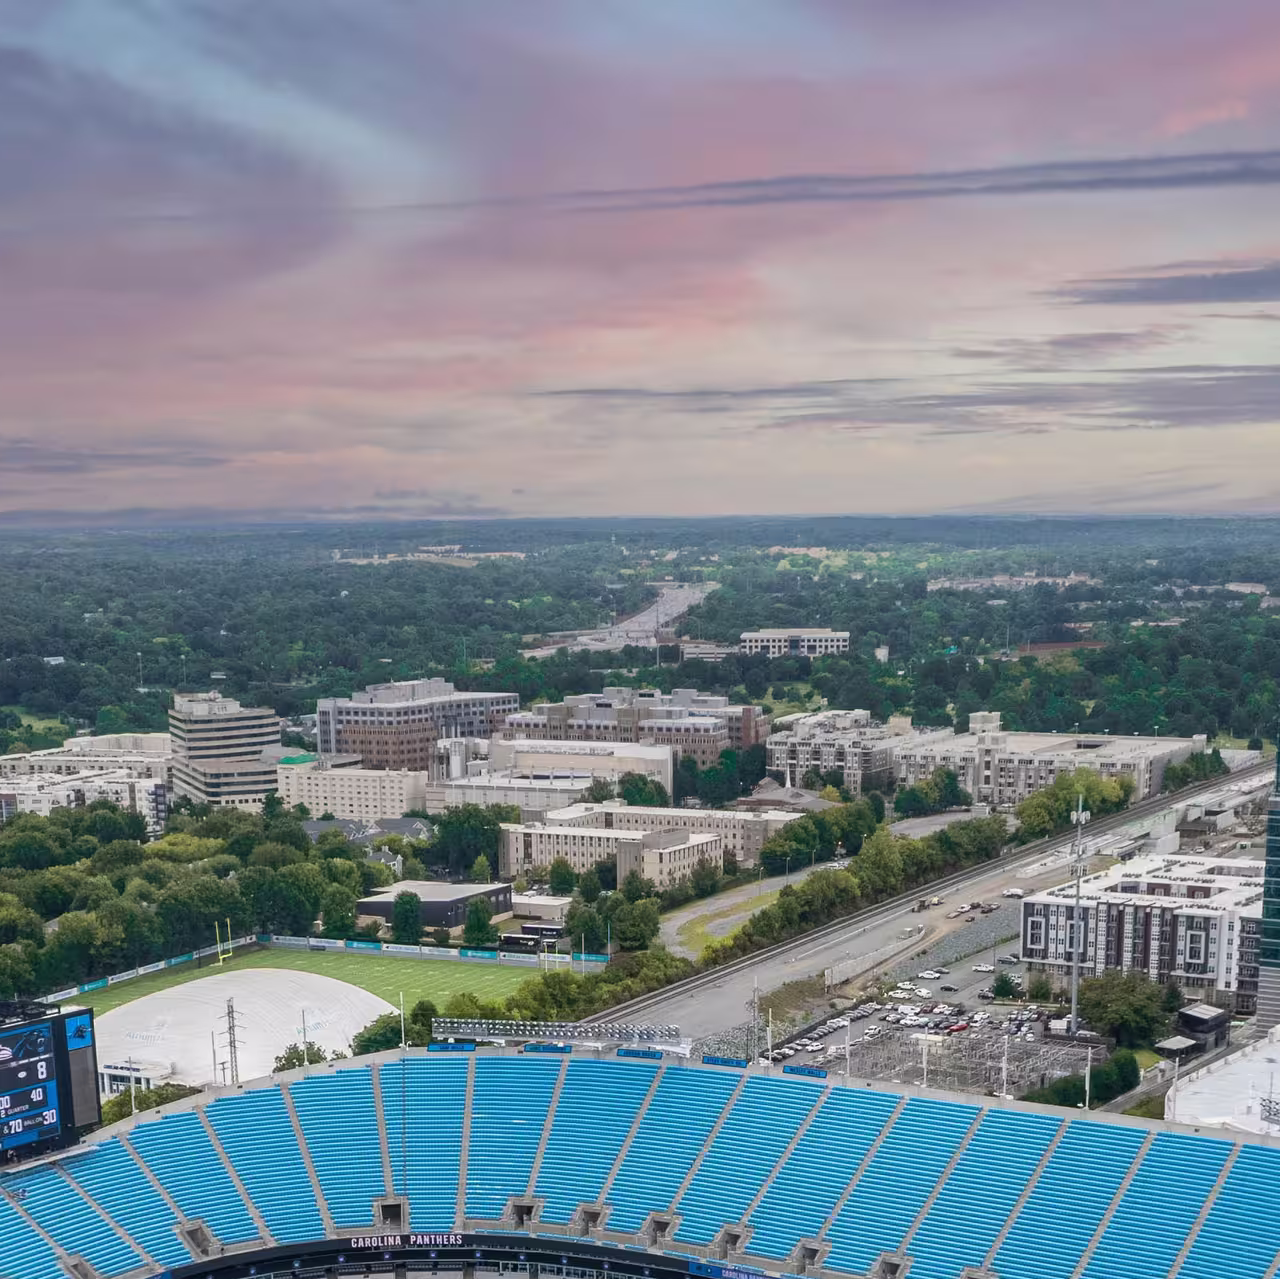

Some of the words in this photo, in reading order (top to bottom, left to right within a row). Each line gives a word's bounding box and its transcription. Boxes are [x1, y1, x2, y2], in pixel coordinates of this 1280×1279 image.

[37, 1061, 47, 1079] 8
[30, 1088, 43, 1101] 40
[0, 1110, 6, 1118] 2
[9, 1119, 23, 1134] 70
[42, 1109, 57, 1125] 30
[351, 1236, 402, 1248] CAROLINA
[410, 1234, 462, 1245] PANTHERS
